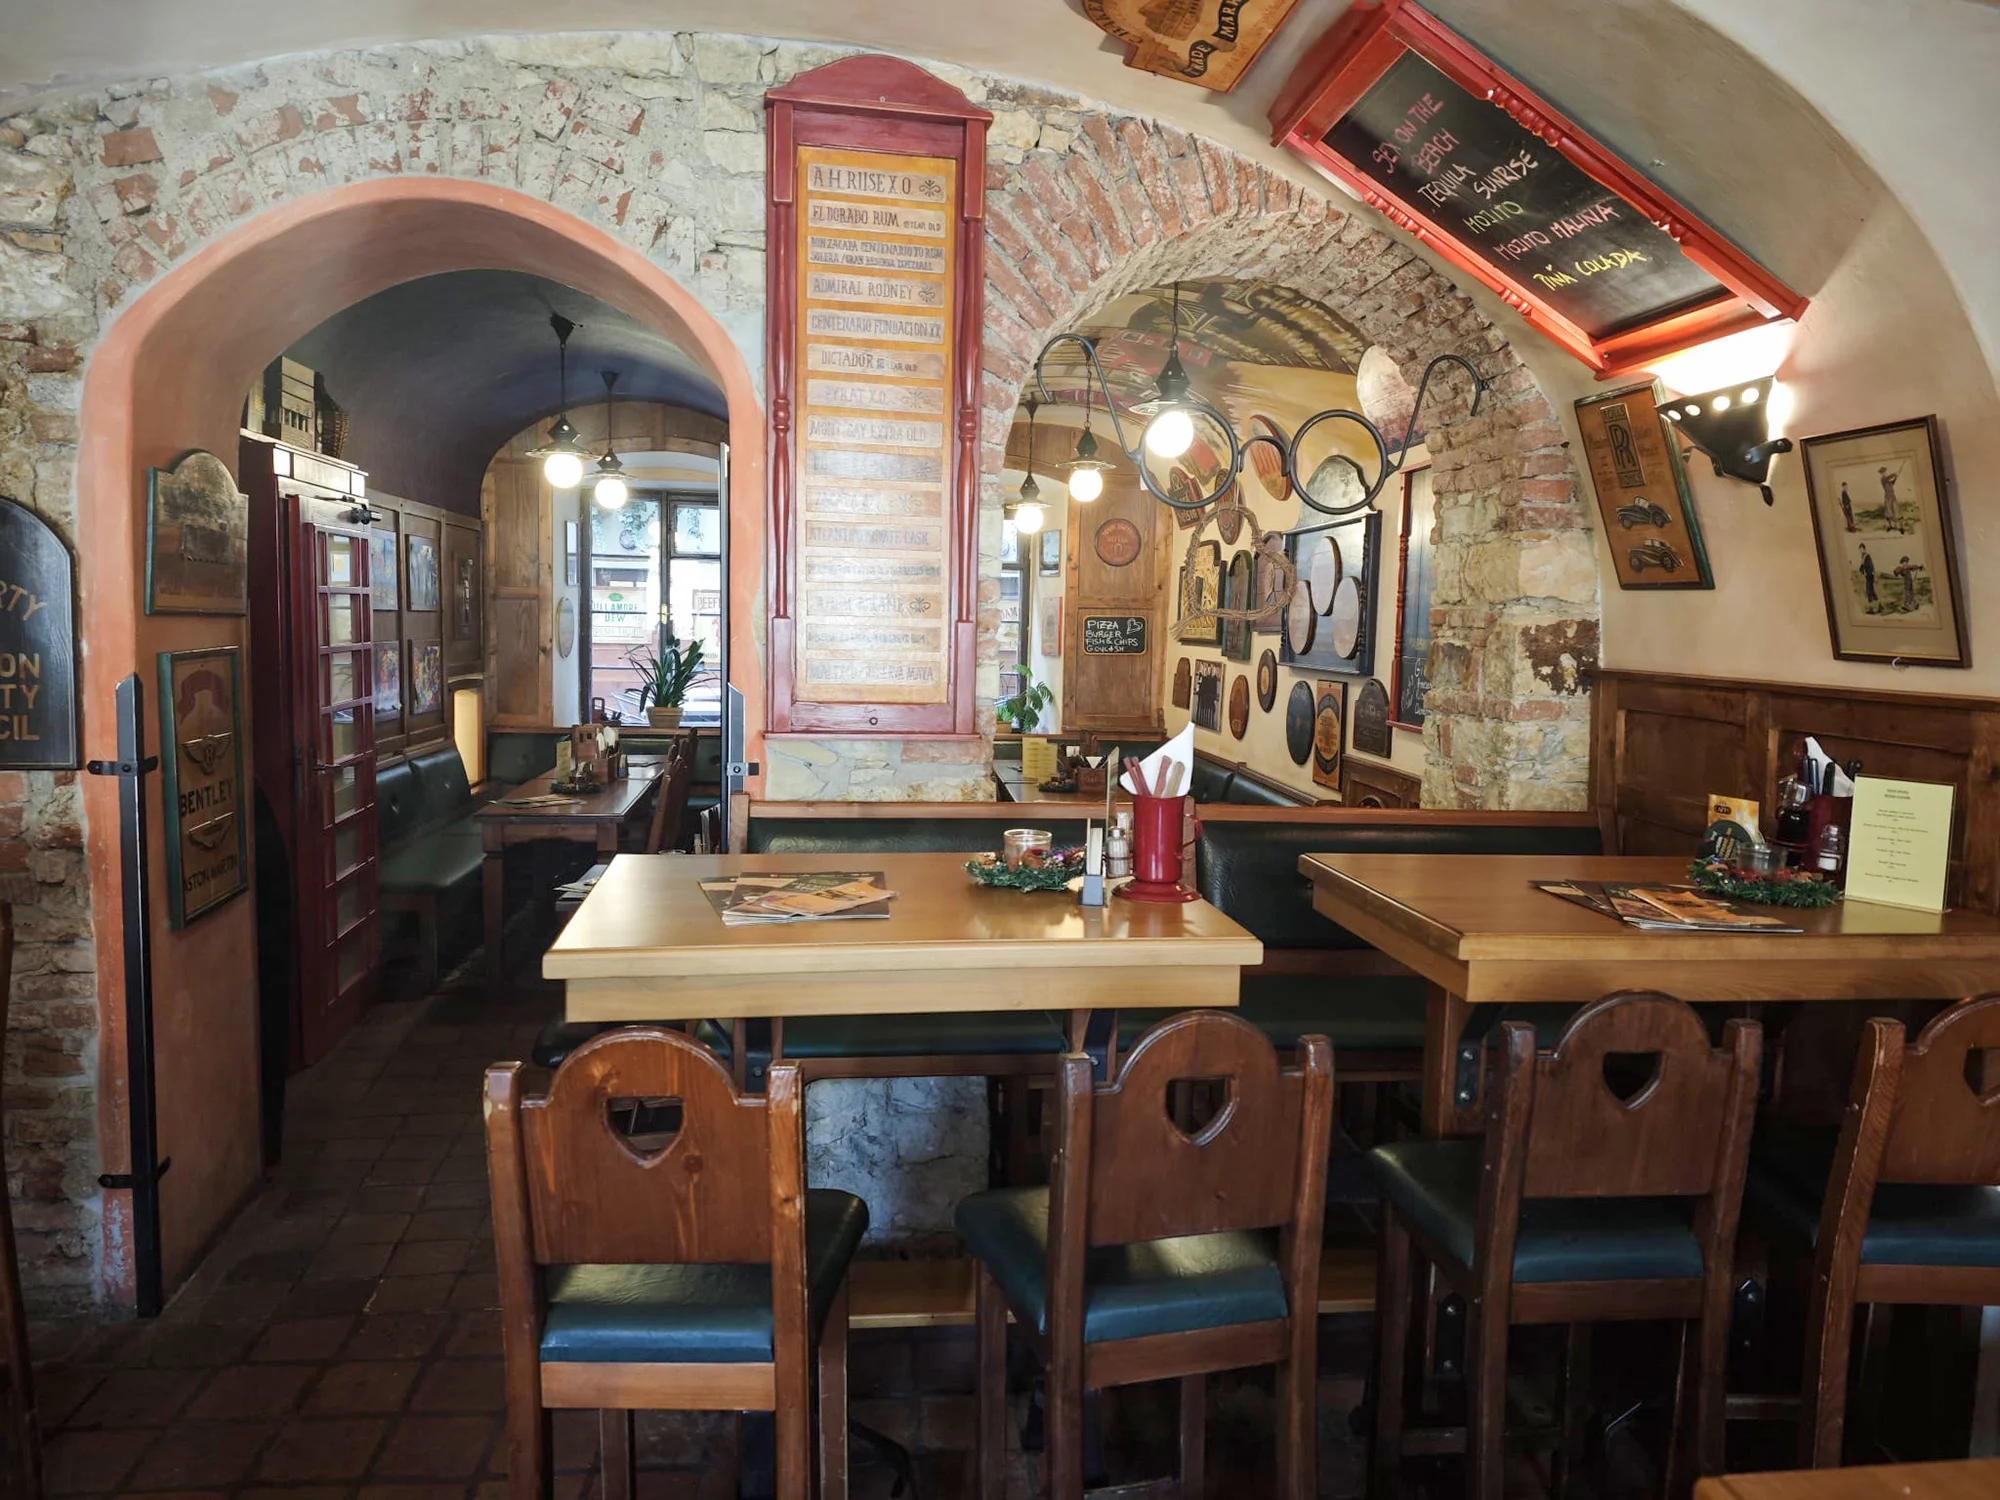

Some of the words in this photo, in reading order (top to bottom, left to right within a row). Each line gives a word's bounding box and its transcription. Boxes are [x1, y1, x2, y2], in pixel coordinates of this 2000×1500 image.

[1186, 43, 1212, 76] TRADE
[1372, 140, 1402, 174] SEX
[1394, 118, 1418, 145] ON
[1407, 92, 1446, 125] THE
[1411, 127, 1460, 175] BEACH
[847, 170, 885, 193] RIISE
[1417, 163, 1477, 208] TEQUILA
[1473, 149, 1539, 200] SUNRISE
[813, 205, 826, 221] EL
[827, 207, 868, 225] DORADO
[872, 210, 900, 228] RUM
[928, 222, 942, 231] OLD
[1463, 200, 1524, 235] MOJITO
[1493, 230, 1551, 261] MOJITO
[1550, 203, 1622, 239] MALINA
[827, 238, 858, 251] ZACAPA
[1575, 249, 1647, 276] COLADA
[812, 278, 863, 296] ADMIRAL
[868, 281, 913, 300] RODNEY
[811, 314, 872, 333] CENTENARIO
[821, 350, 874, 369] DICTADOR
[905, 426, 927, 442] OLD
[904, 529, 930, 546] CASK
[1085, 630, 1123, 639] BURGER
[1087, 619, 1119, 630] PIZZA
[1113, 637, 1139, 647] CHIPS
[180, 779, 234, 818] BENTLEY
